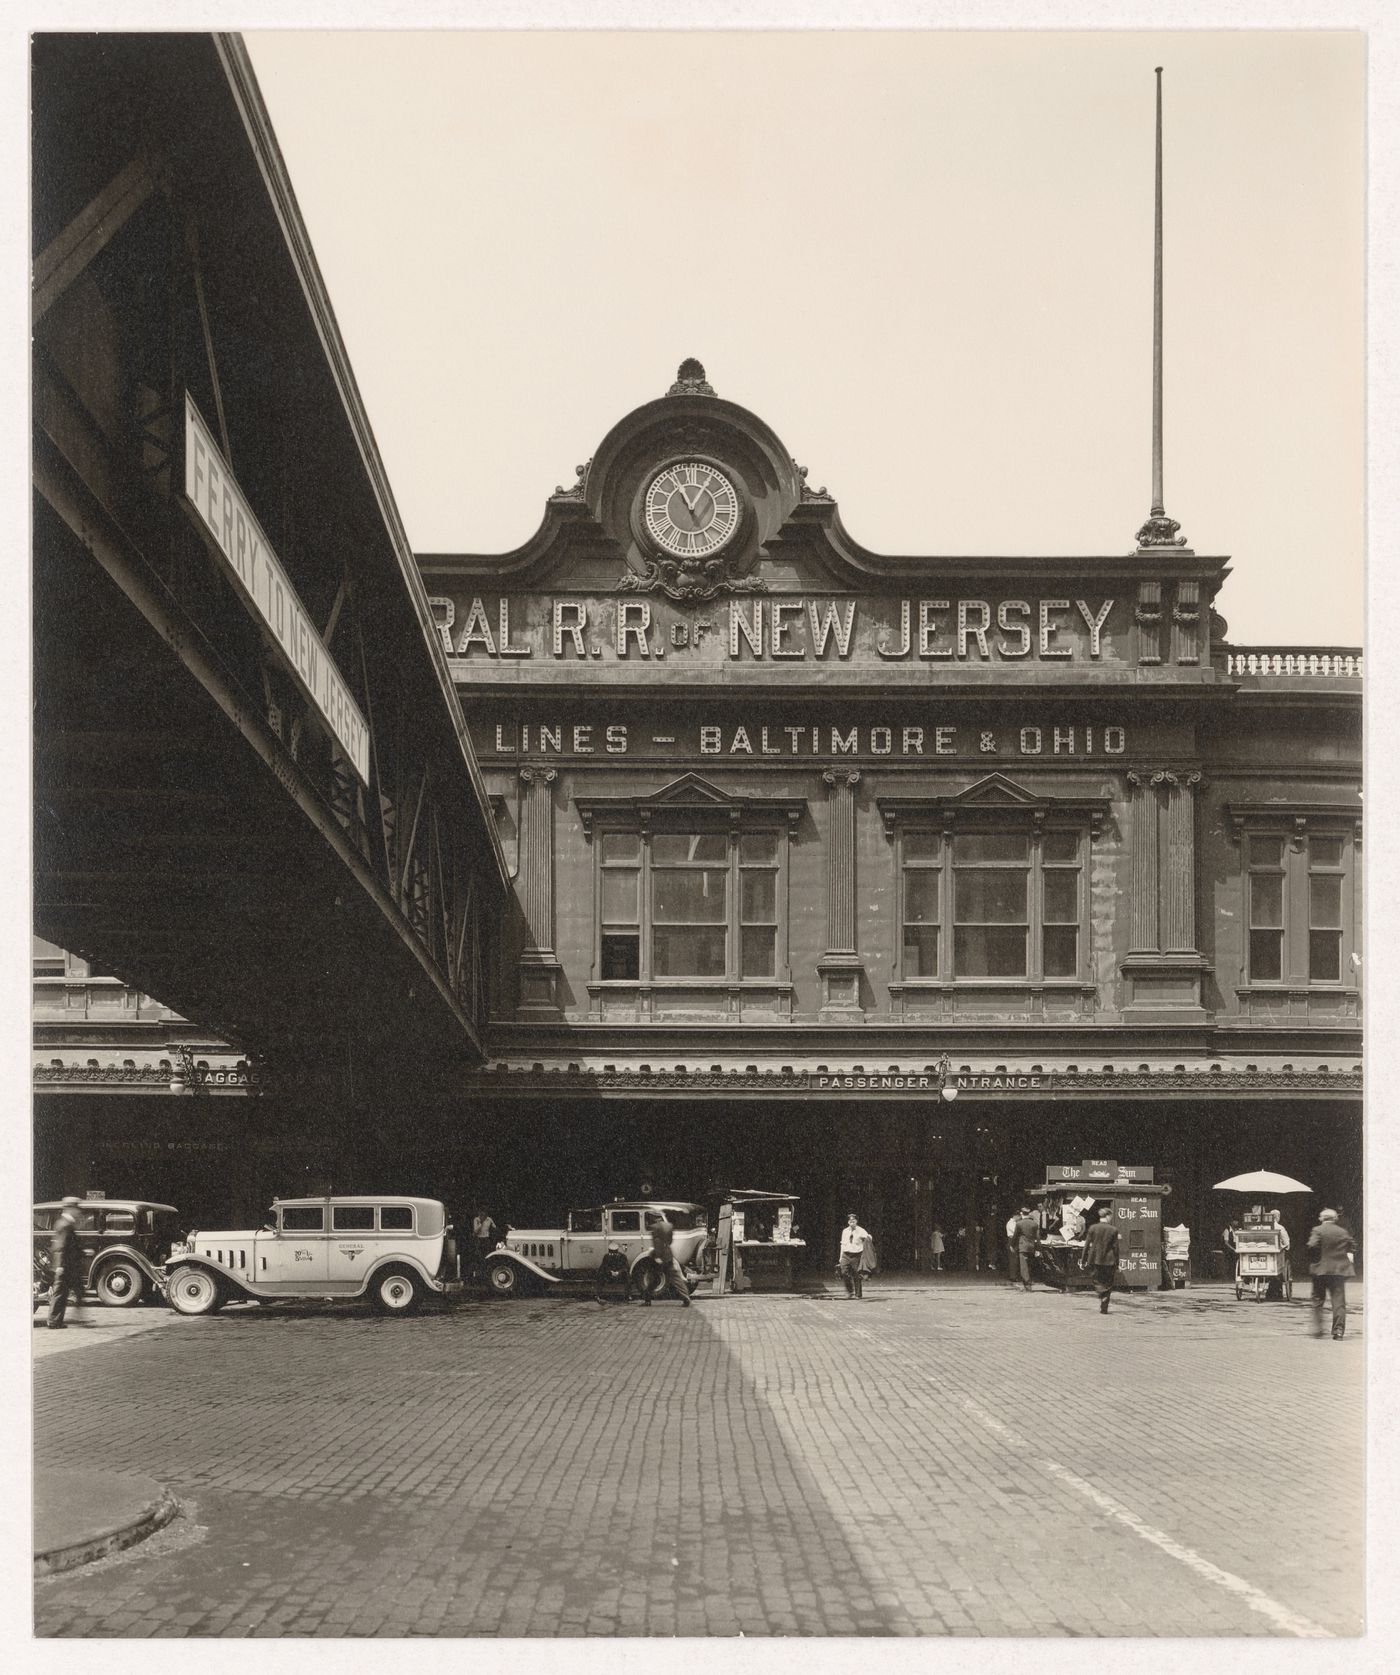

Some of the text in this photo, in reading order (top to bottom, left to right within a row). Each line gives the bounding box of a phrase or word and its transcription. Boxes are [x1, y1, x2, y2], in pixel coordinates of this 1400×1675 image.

[194, 430, 362, 768] FERRY TO NEW JERSEY
[670, 621, 713, 646] OF
[729, 600, 857, 657] NEW
[877, 600, 1115, 657] JERSEY
[495, 724, 628, 753] LINES
[700, 726, 958, 755] BALTIMORE
[979, 731, 996, 752] &
[1020, 727, 1126, 755] OHIO
[819, 1077, 1042, 1089] PASSENGER NTRANCE
[1062, 1166, 1136, 1178] The Sun
[1118, 1206, 1158, 1220] The Sun
[1118, 1258, 1158, 1271] The Sun
[1172, 1267, 1187, 1278] The
